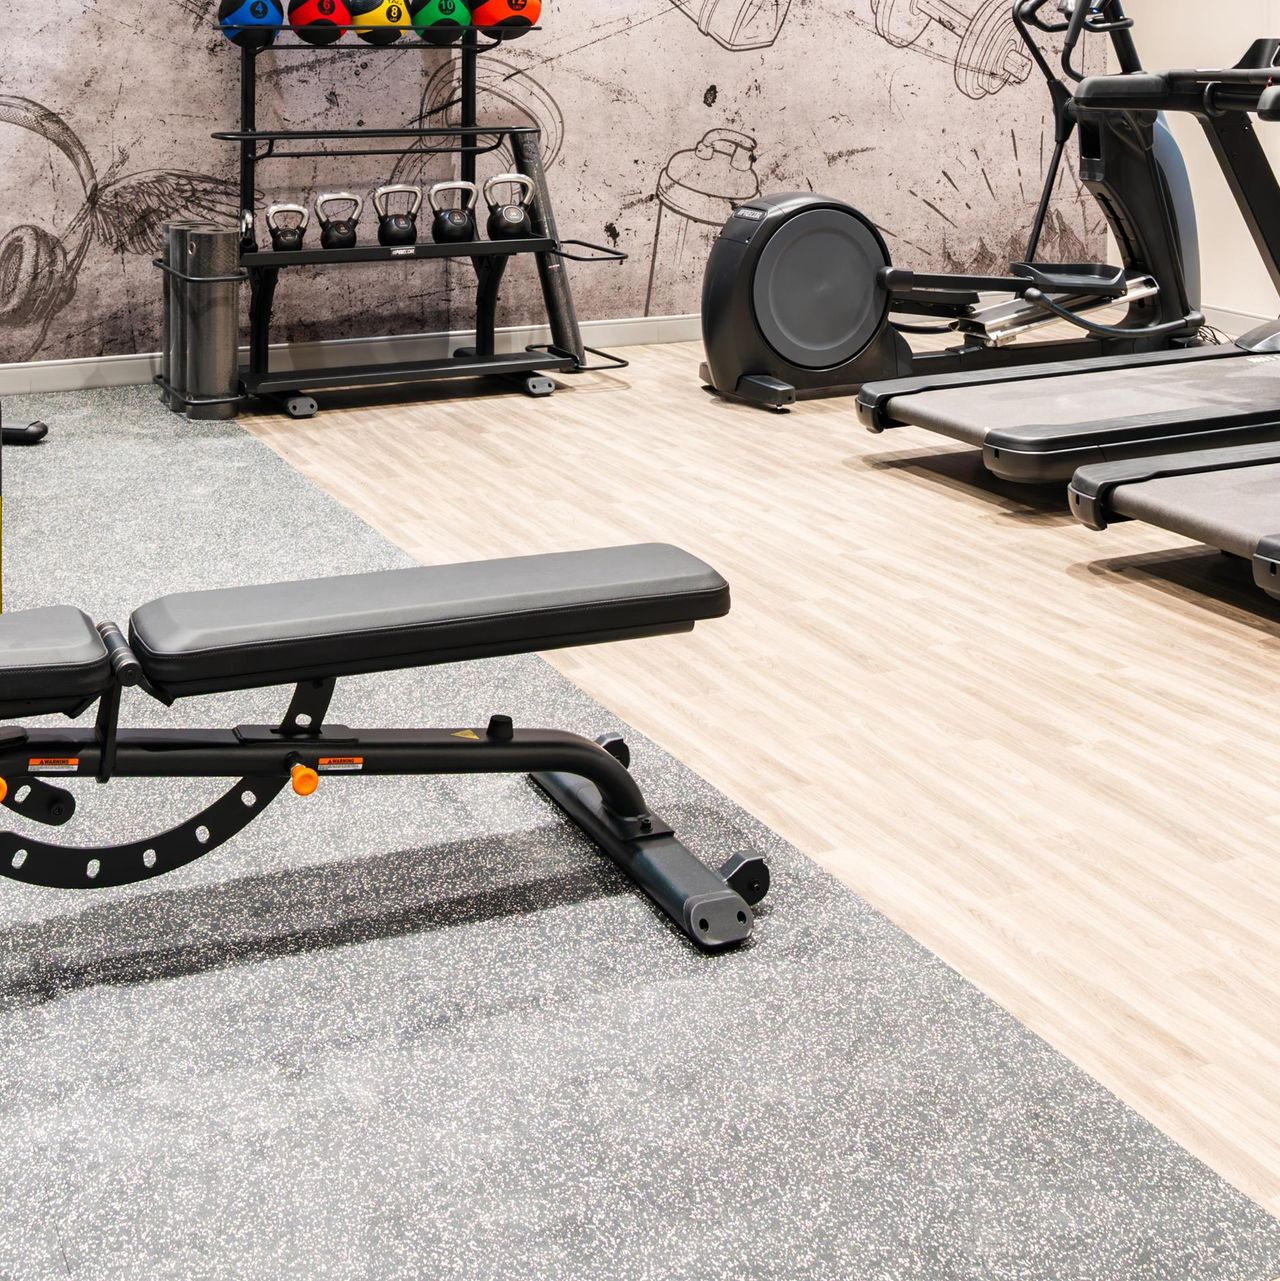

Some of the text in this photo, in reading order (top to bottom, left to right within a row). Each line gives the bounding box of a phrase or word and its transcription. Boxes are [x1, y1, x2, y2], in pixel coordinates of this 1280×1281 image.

[255, 3, 263, 13] 4
[322, 0, 331, 10] 6
[439, 0, 454, 10] 10
[390, 6, 399, 17] 8
